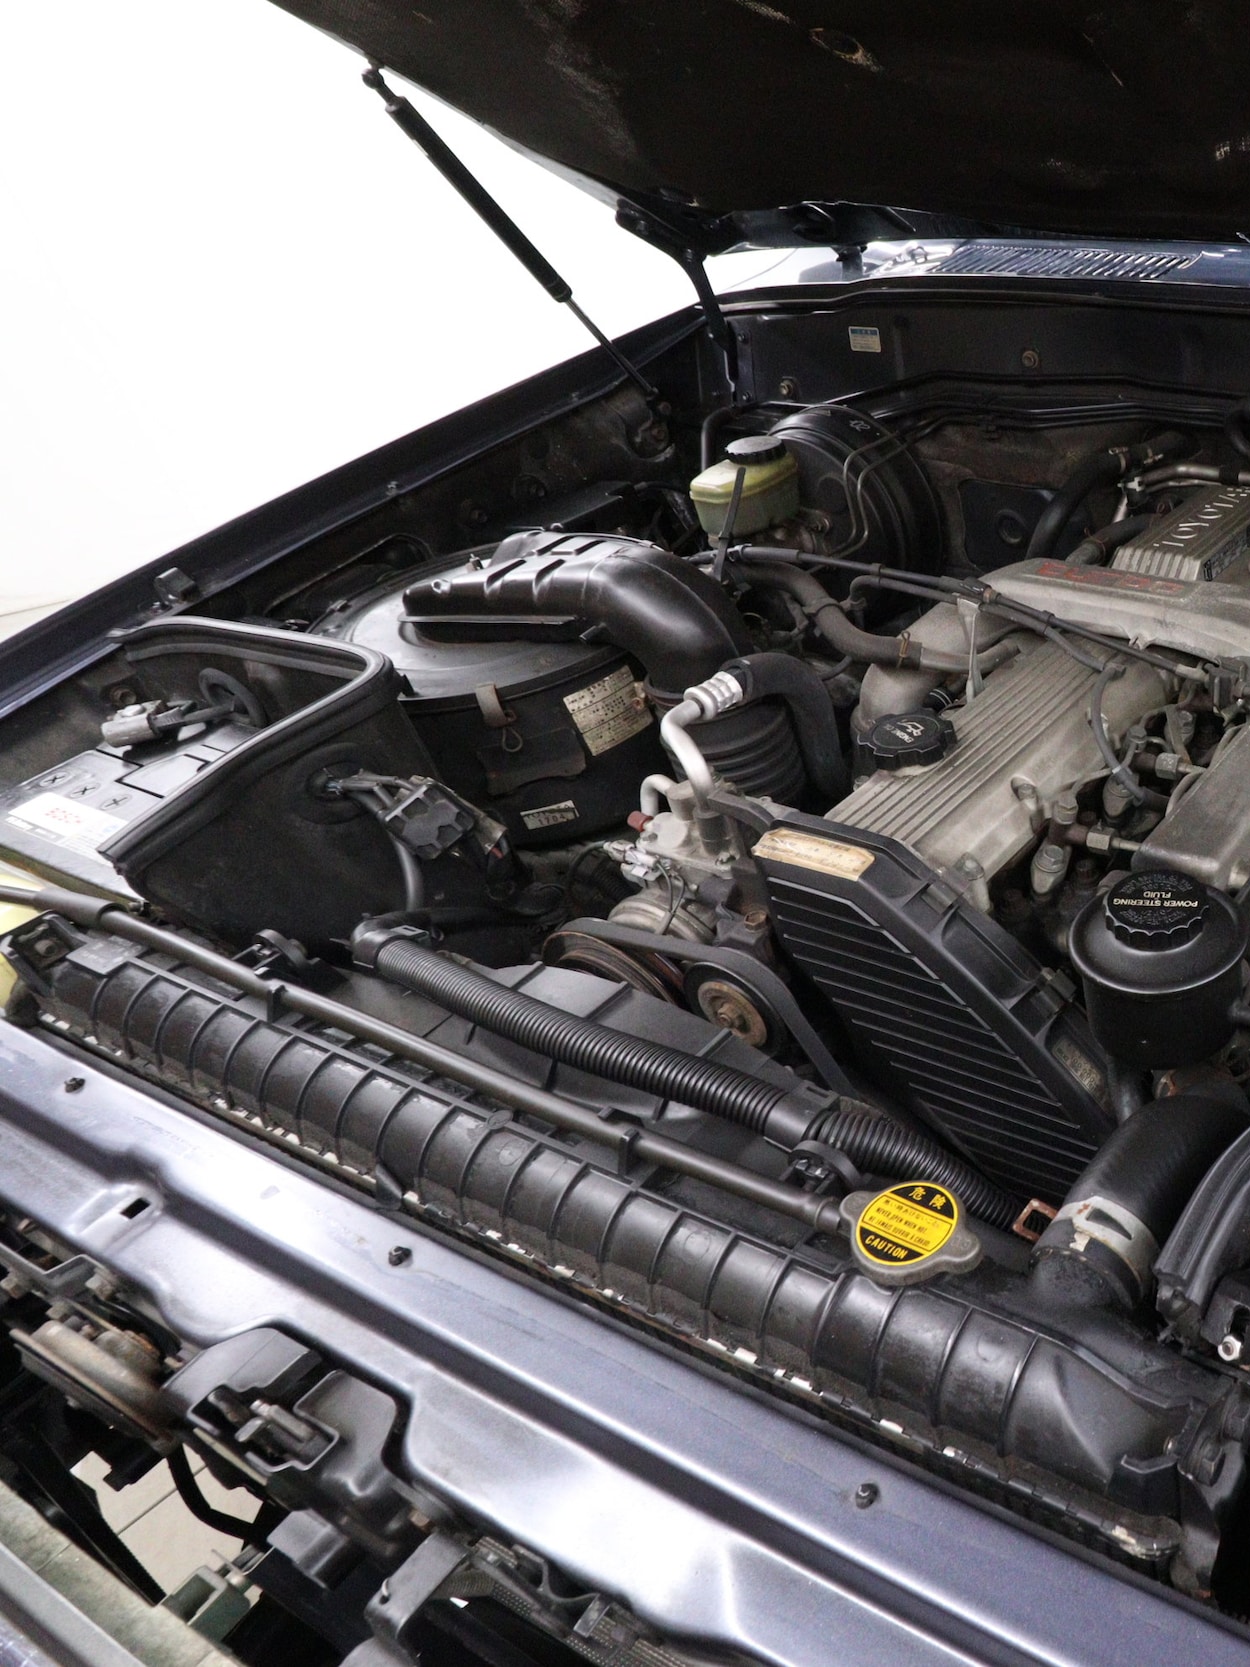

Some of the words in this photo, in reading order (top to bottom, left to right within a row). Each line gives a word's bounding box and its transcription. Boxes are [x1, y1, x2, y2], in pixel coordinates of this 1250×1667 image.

[1112, 897, 1161, 907] STEERING
[1143, 890, 1172, 899] FLUID
[1163, 899, 1199, 908] POWER
[908, 1186, 947, 1210] 危険
[876, 1207, 891, 1218] NEVER
[891, 1213, 903, 1223] OPEN
[904, 1219, 917, 1230] WHEN
[865, 1234, 909, 1260] CAUTION
